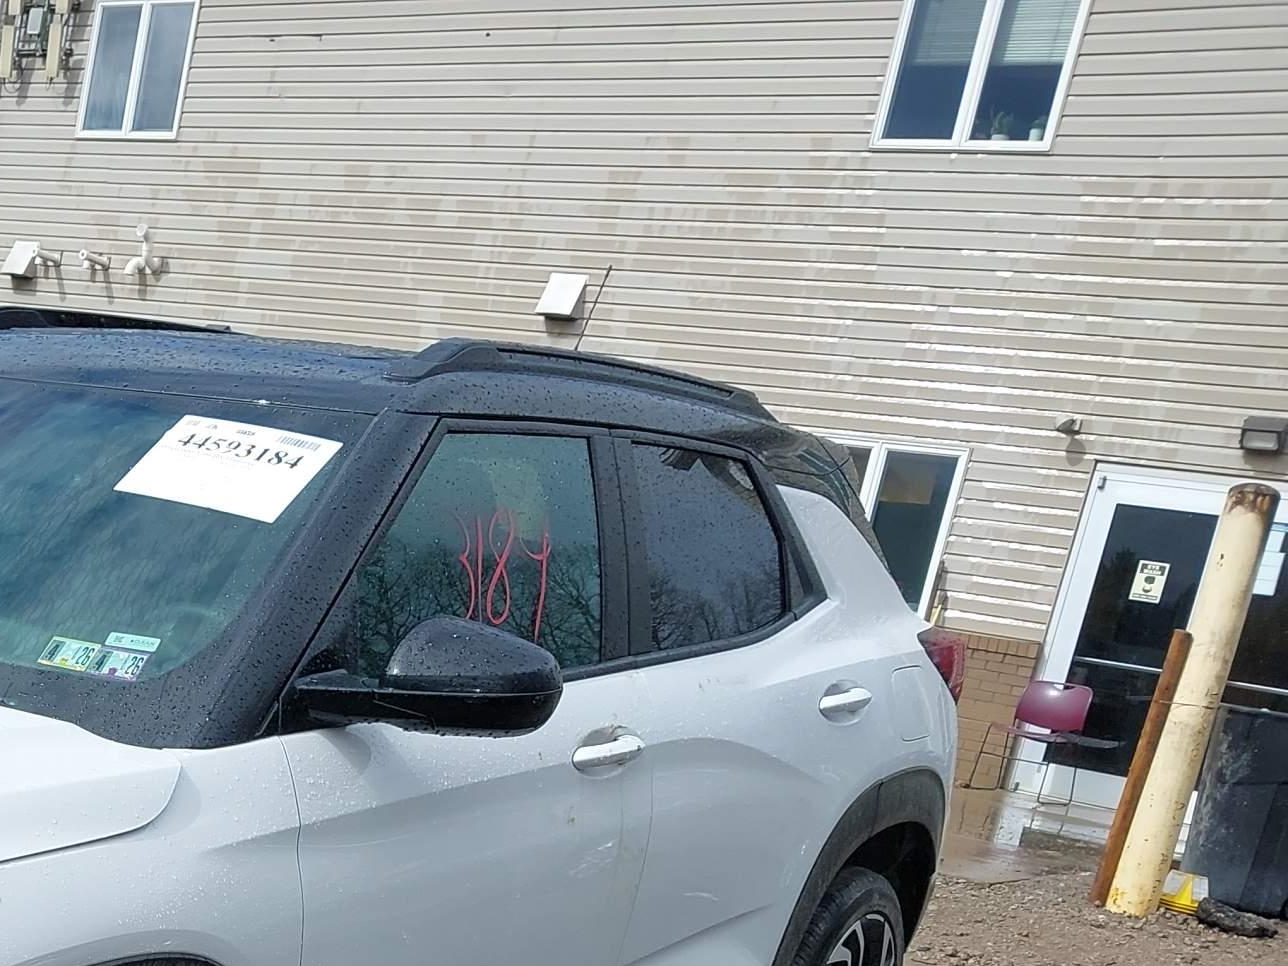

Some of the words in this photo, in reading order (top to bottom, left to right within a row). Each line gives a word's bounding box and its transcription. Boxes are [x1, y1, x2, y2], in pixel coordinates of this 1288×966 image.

[178, 433, 305, 469] 44593184
[47, 644, 60, 660] 4
[76, 646, 95, 666] 26
[93, 654, 107, 672] 4
[125, 656, 144, 675] 26
